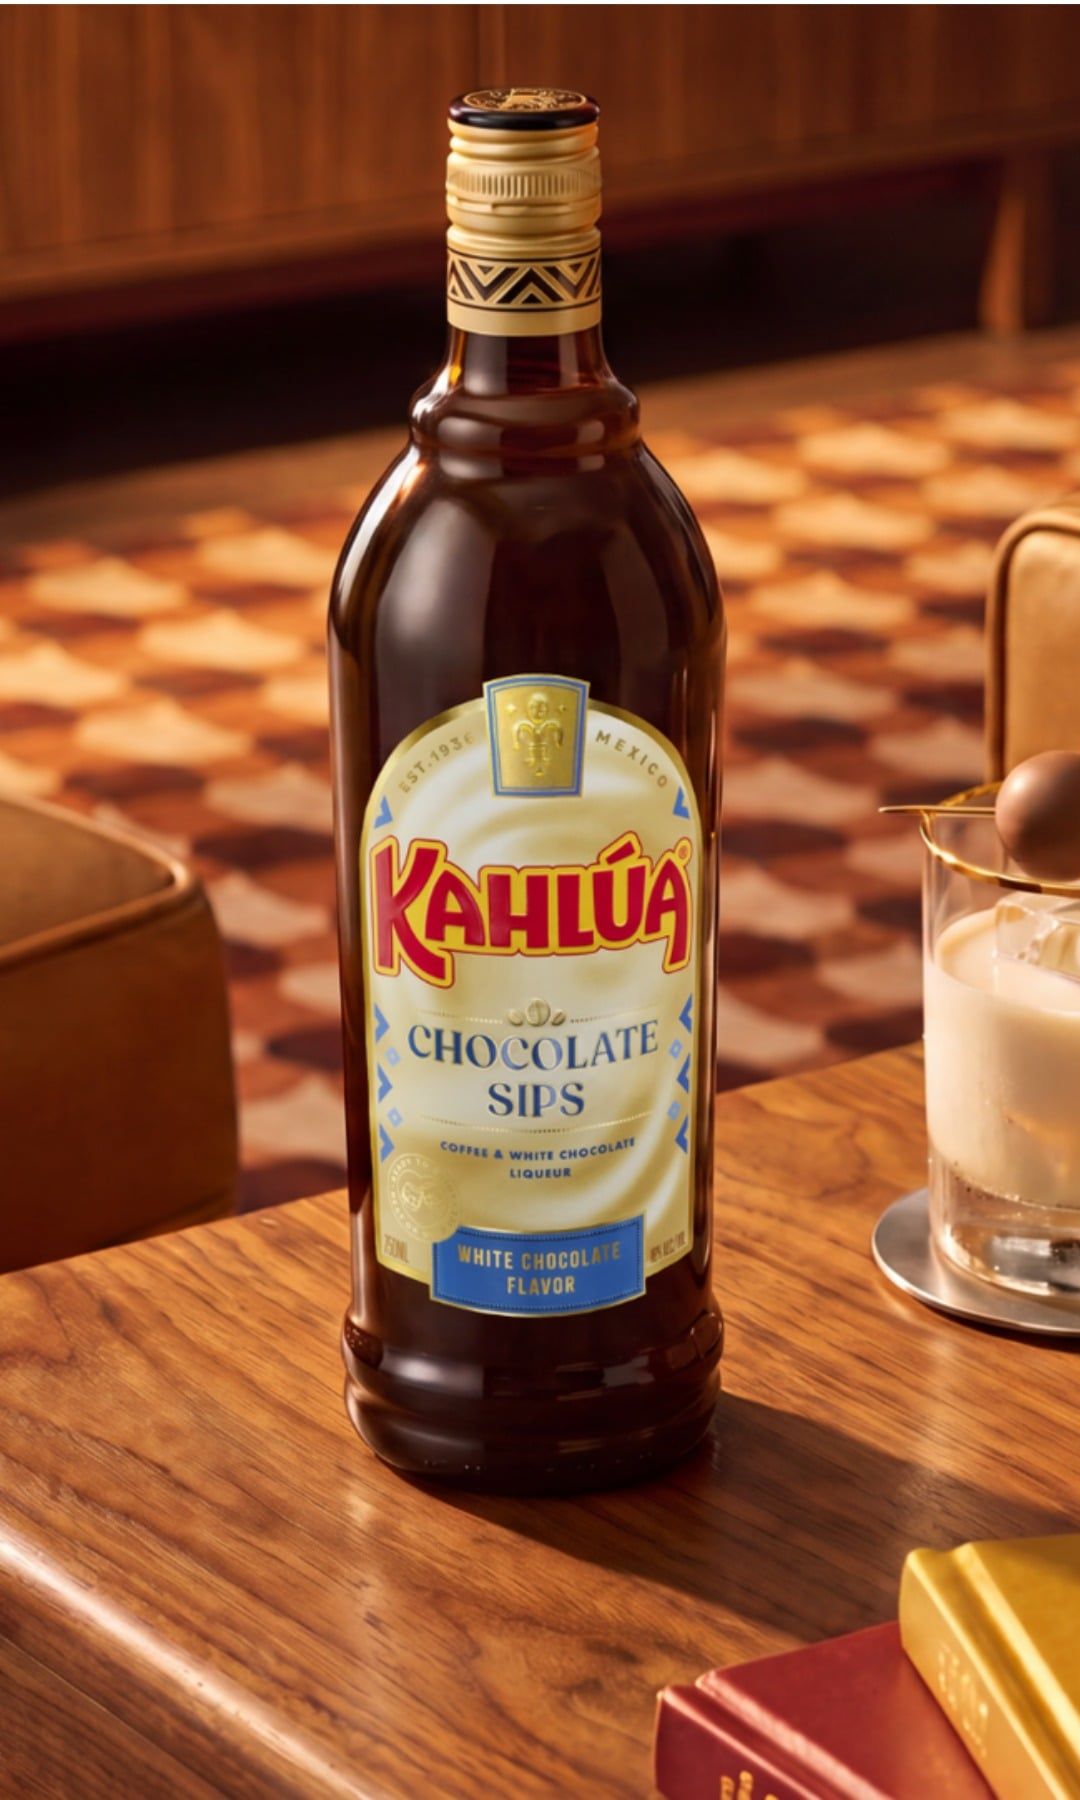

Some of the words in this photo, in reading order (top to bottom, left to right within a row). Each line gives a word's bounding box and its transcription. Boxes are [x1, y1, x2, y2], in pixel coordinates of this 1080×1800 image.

[595, 729, 668, 788] MEXICO
[371, 832, 691, 987] KAHLÚA
[407, 1019, 660, 1071] CHOCOLATE
[487, 1082, 585, 1118] SIPS
[440, 1140, 488, 1159] COFFEE
[493, 1149, 504, 1160] &
[509, 1150, 554, 1161] WHITE
[559, 1136, 636, 1161] CHOCOLATE
[509, 1167, 572, 1179] LIQUEUR
[456, 1243, 514, 1270] WHITE
[520, 1240, 622, 1271] CHOCOLATE
[506, 1275, 576, 1296] FLAVOR
